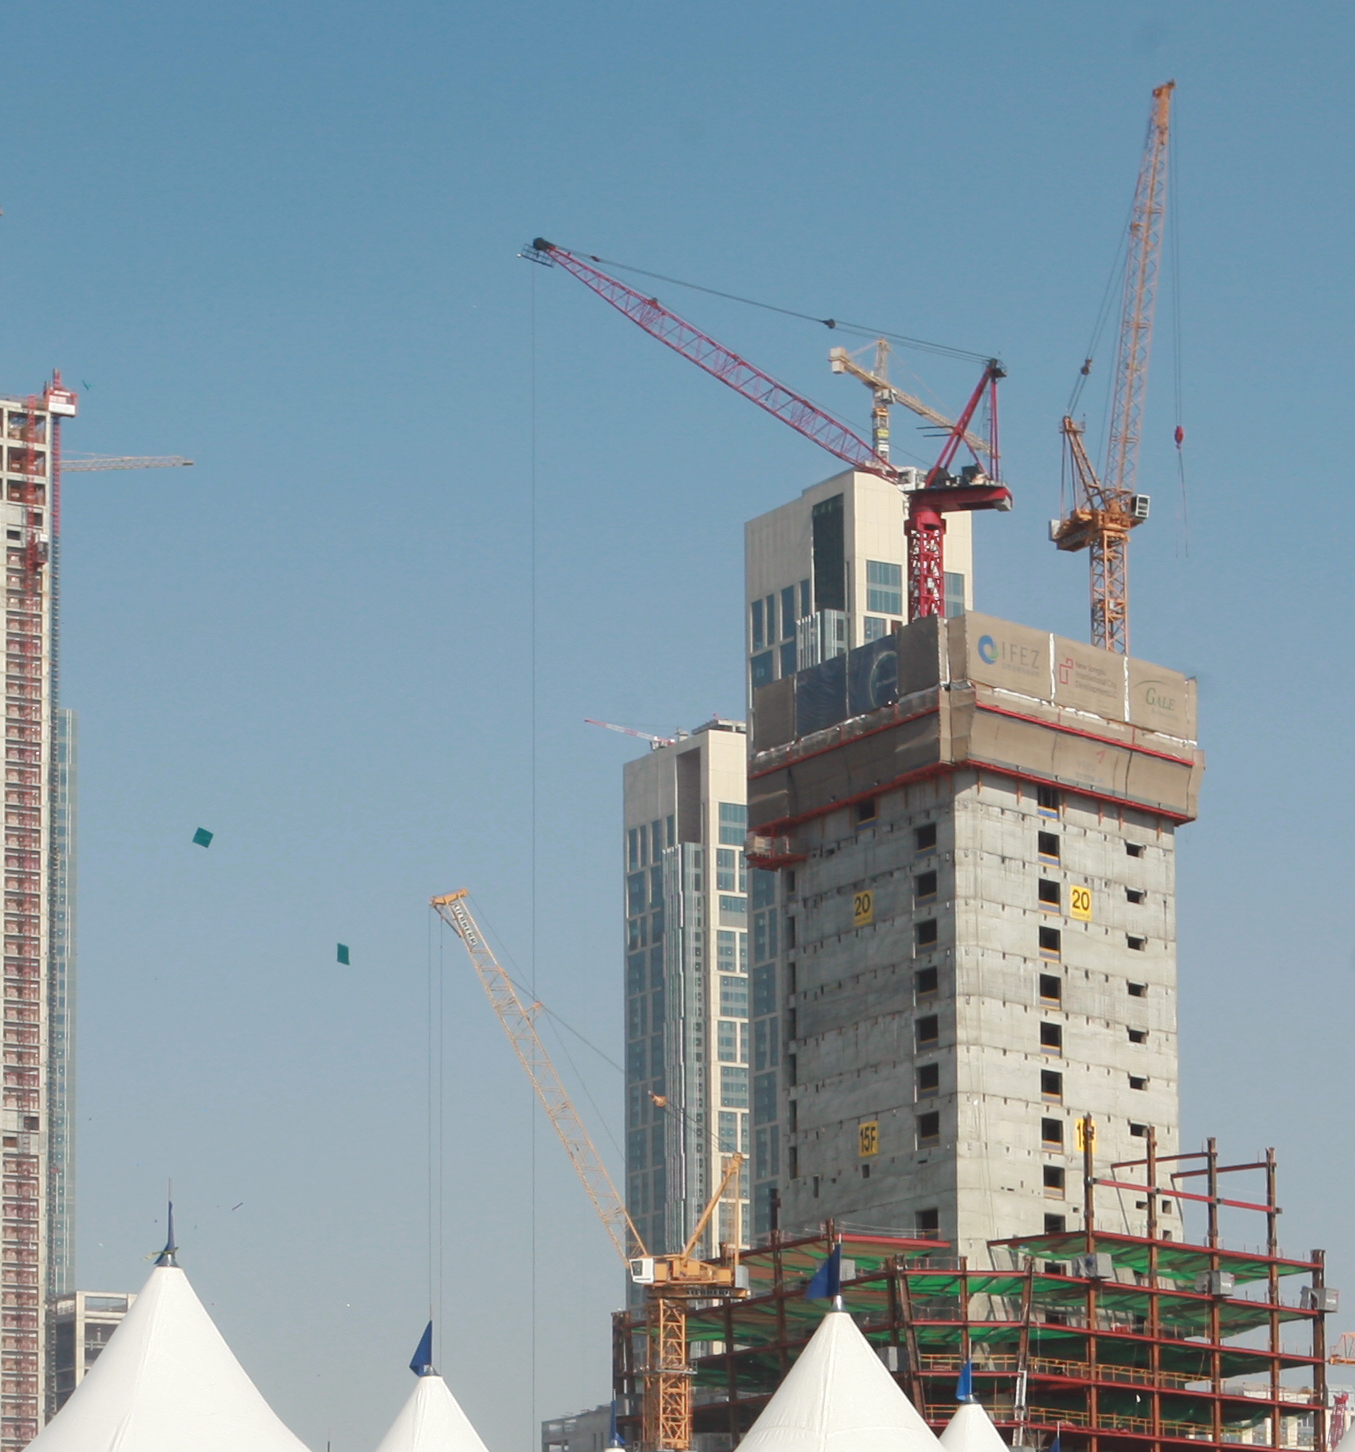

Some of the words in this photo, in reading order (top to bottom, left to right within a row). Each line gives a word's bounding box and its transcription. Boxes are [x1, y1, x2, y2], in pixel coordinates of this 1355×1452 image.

[1002, 641, 1040, 669] IFEZ
[854, 893, 871, 917] 20
[1072, 888, 1090, 911] 20
[860, 1126, 876, 1152] 15F
